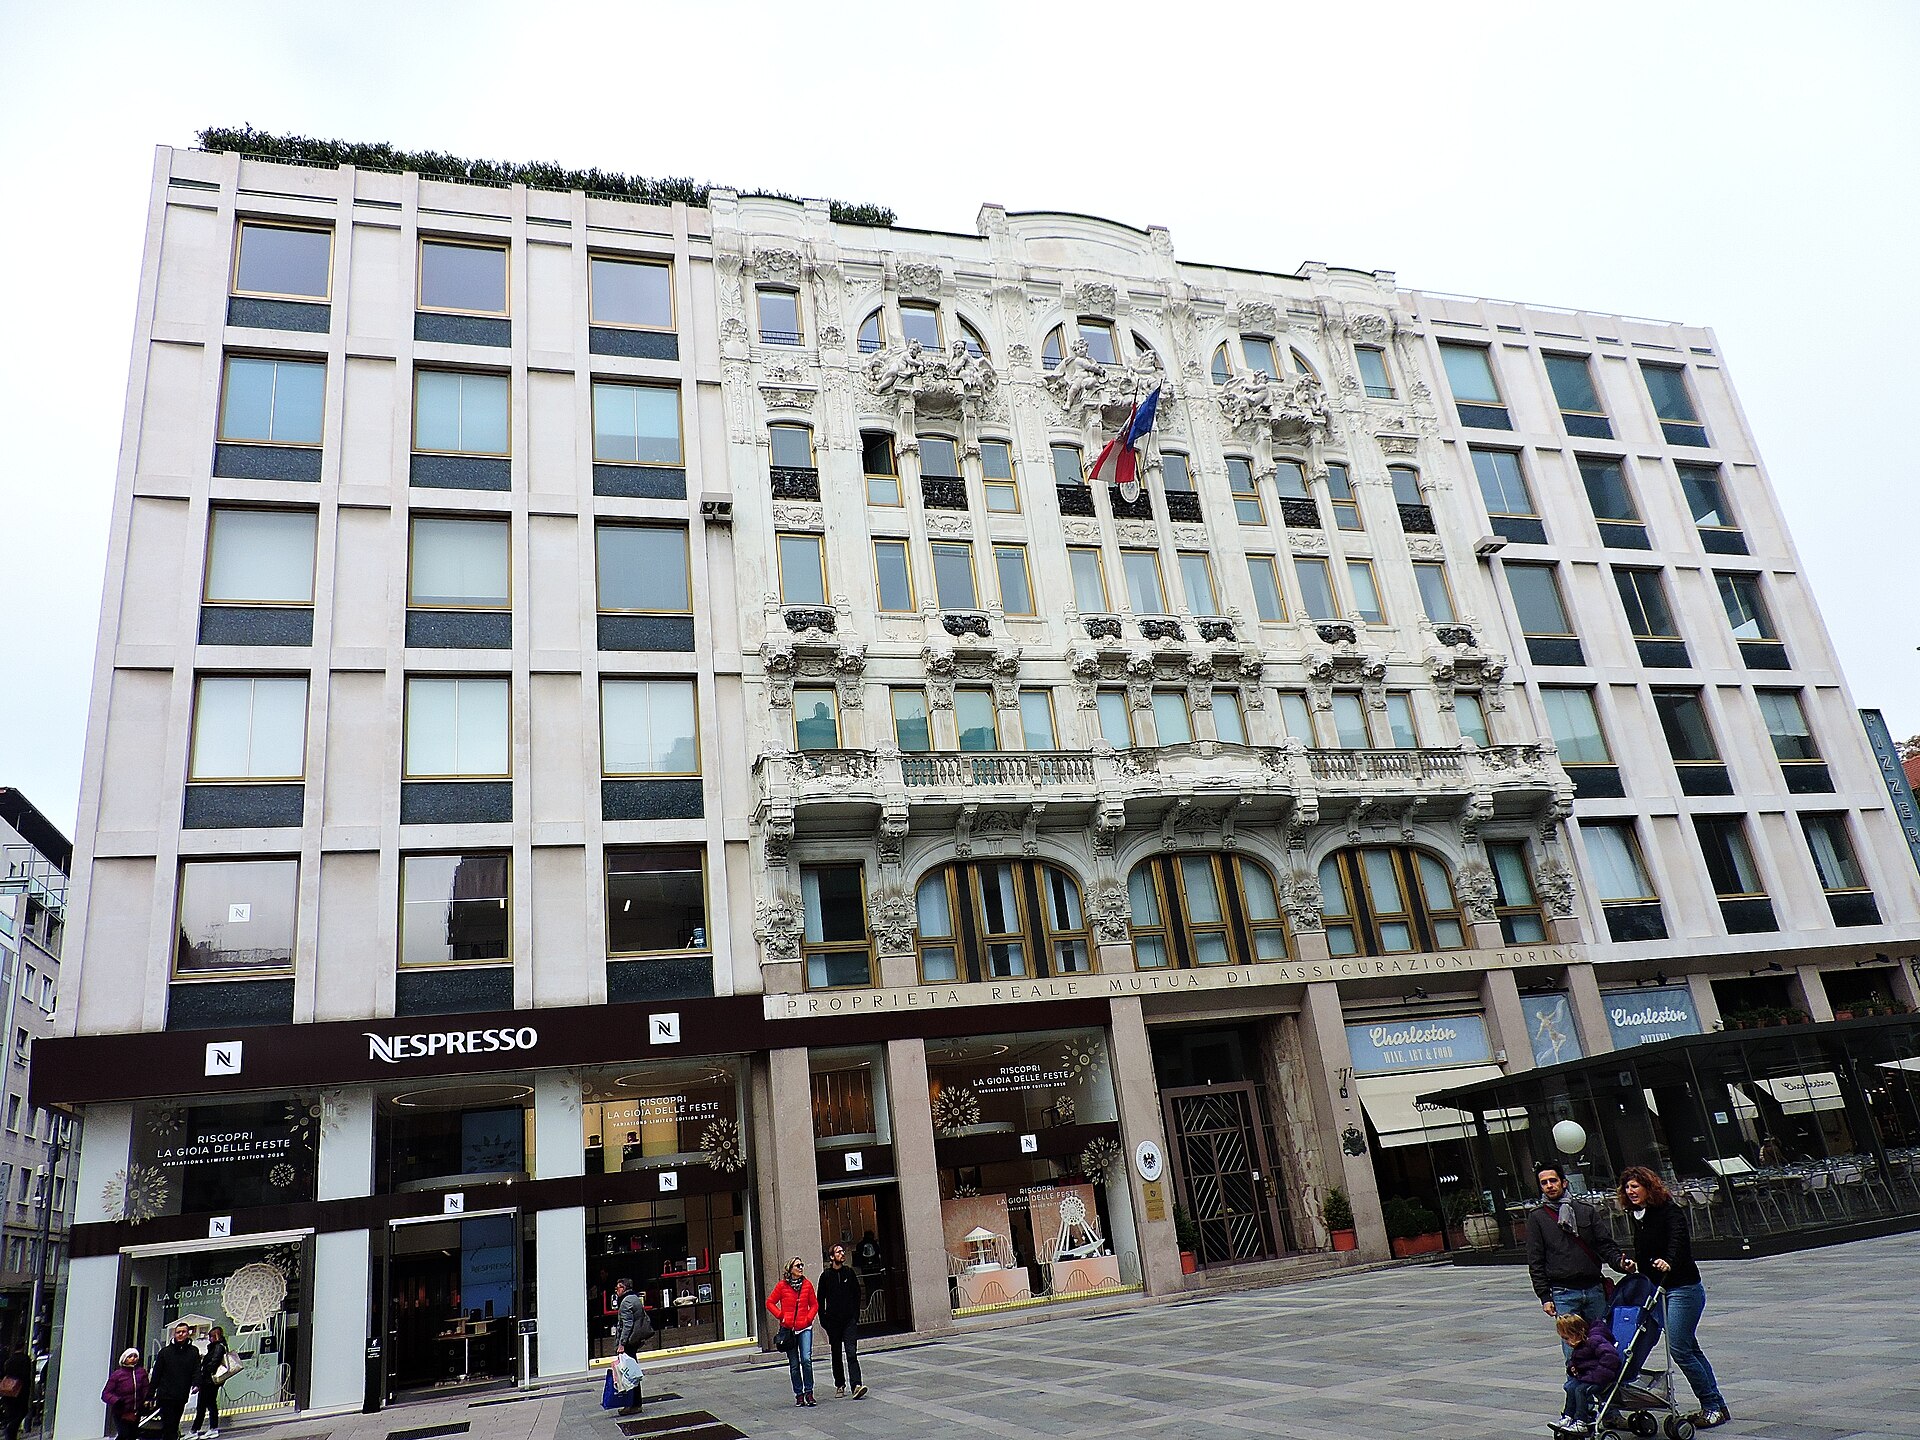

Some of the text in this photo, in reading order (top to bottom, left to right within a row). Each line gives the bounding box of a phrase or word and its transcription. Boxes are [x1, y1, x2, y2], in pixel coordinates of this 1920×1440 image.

[991, 982, 1078, 1000] REALE
[1109, 974, 1199, 992] MUTUA
[1227, 971, 1252, 984] DI
[1280, 956, 1474, 980] ASSICURAZIONI
[1497, 948, 1580, 964] TORINO
[1611, 1006, 1688, 1027] Charleston
[1370, 1024, 1457, 1048] Charleston
[362, 1026, 538, 1064] NESPRESSO
[1408, 1048, 1422, 1062] ART
[1426, 1048, 1432, 1060] &
[1433, 1046, 1454, 1060] FOOD
[1000, 1064, 1041, 1075] RISCOPRI
[972, 1070, 1069, 1086] LA GIOIA DELLE FESTE
[640, 1096, 687, 1106] RISCOPRI
[624, 1108, 652, 1118] GIOIA
[654, 1105, 686, 1115] DELLE
[690, 1102, 719, 1112] FESTE
[197, 1132, 253, 1144] RISCOPRI
[157, 1139, 290, 1158] LA GIOIA DELLE FESTE
[1020, 1184, 1056, 1195] RISCOPRI
[996, 1190, 1078, 1206] LA GIOIA DELLE FESTE
[157, 1292, 170, 1302] LA
[174, 1289, 203, 1299] GIOIA
